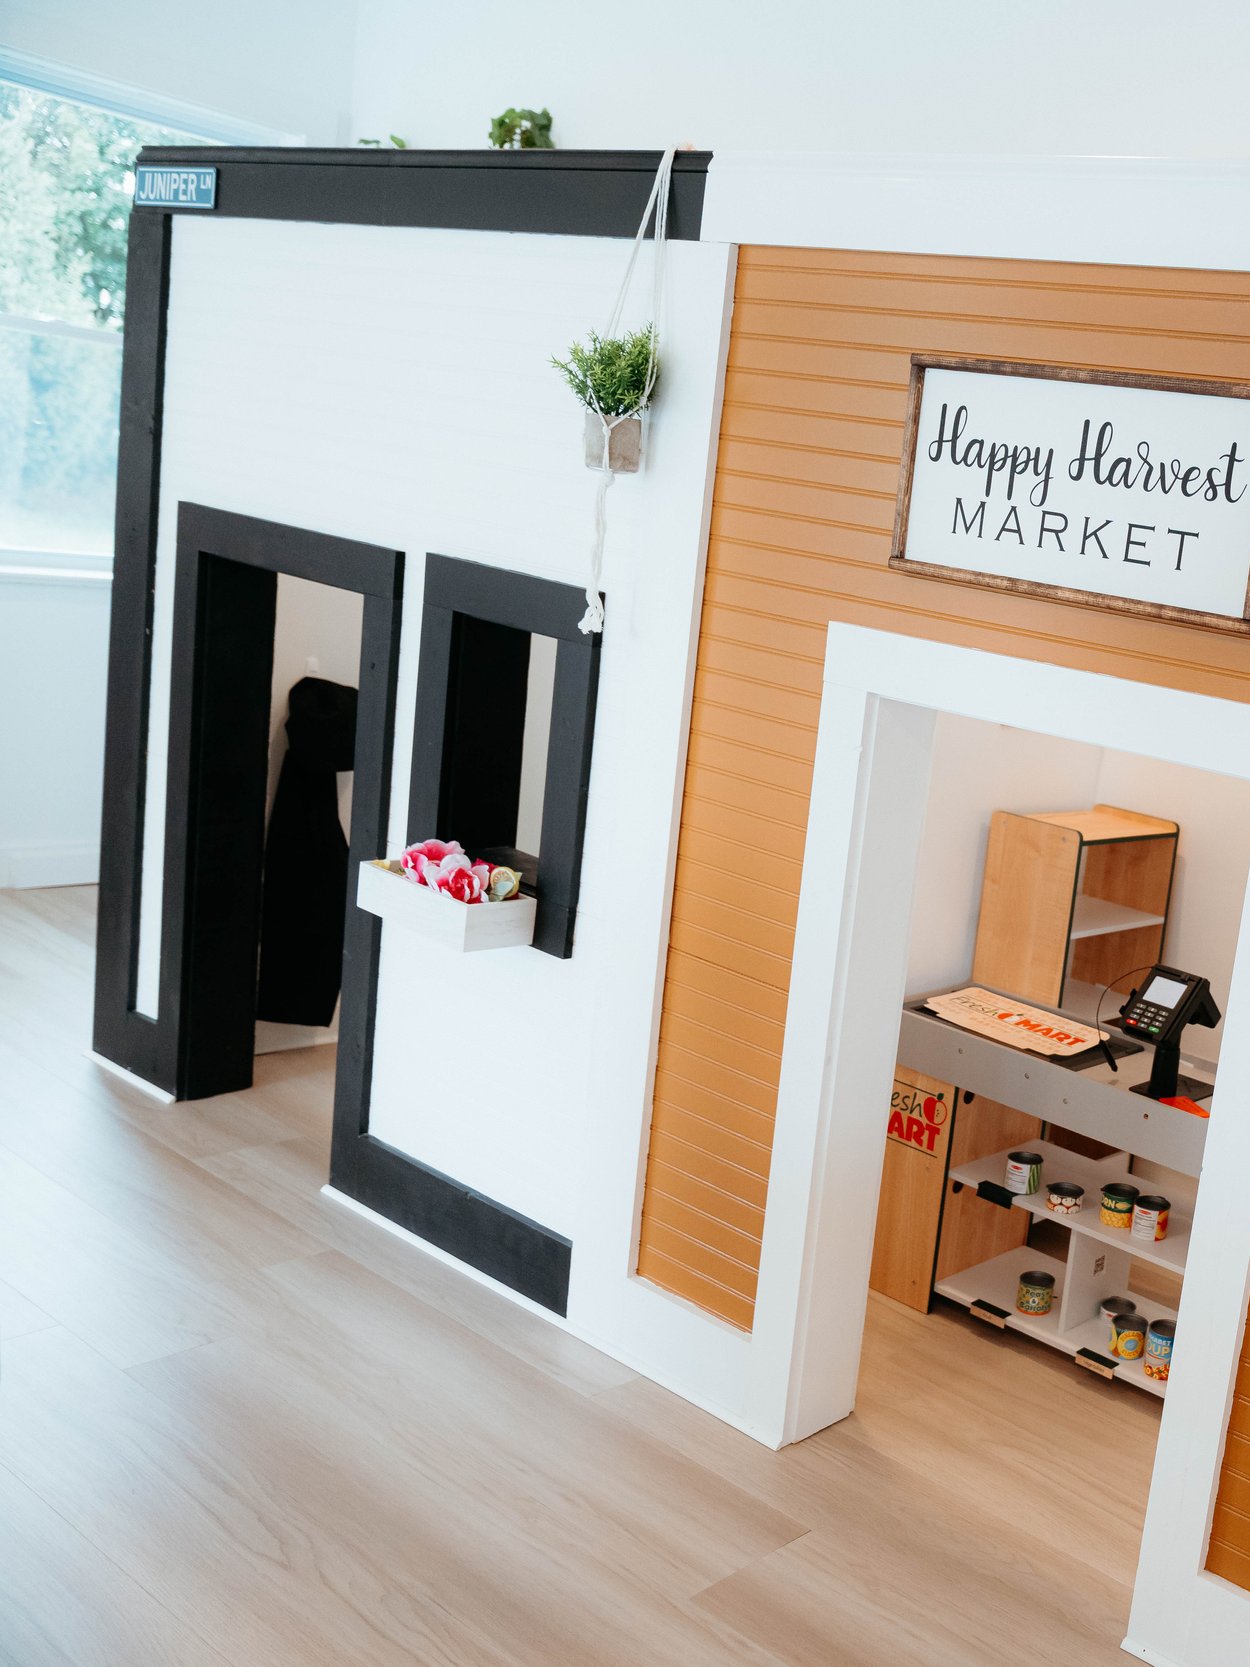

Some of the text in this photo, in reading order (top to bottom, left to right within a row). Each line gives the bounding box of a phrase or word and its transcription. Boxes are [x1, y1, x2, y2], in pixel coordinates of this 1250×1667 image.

[140, 172, 212, 201] JUNIPER LN
[928, 403, 1247, 507] Happy Harvest
[951, 497, 1199, 571] MARKET
[950, 996, 1087, 1047] Fresh MART
[891, 1092, 922, 1118] esh
[888, 1110, 941, 1152] ART
